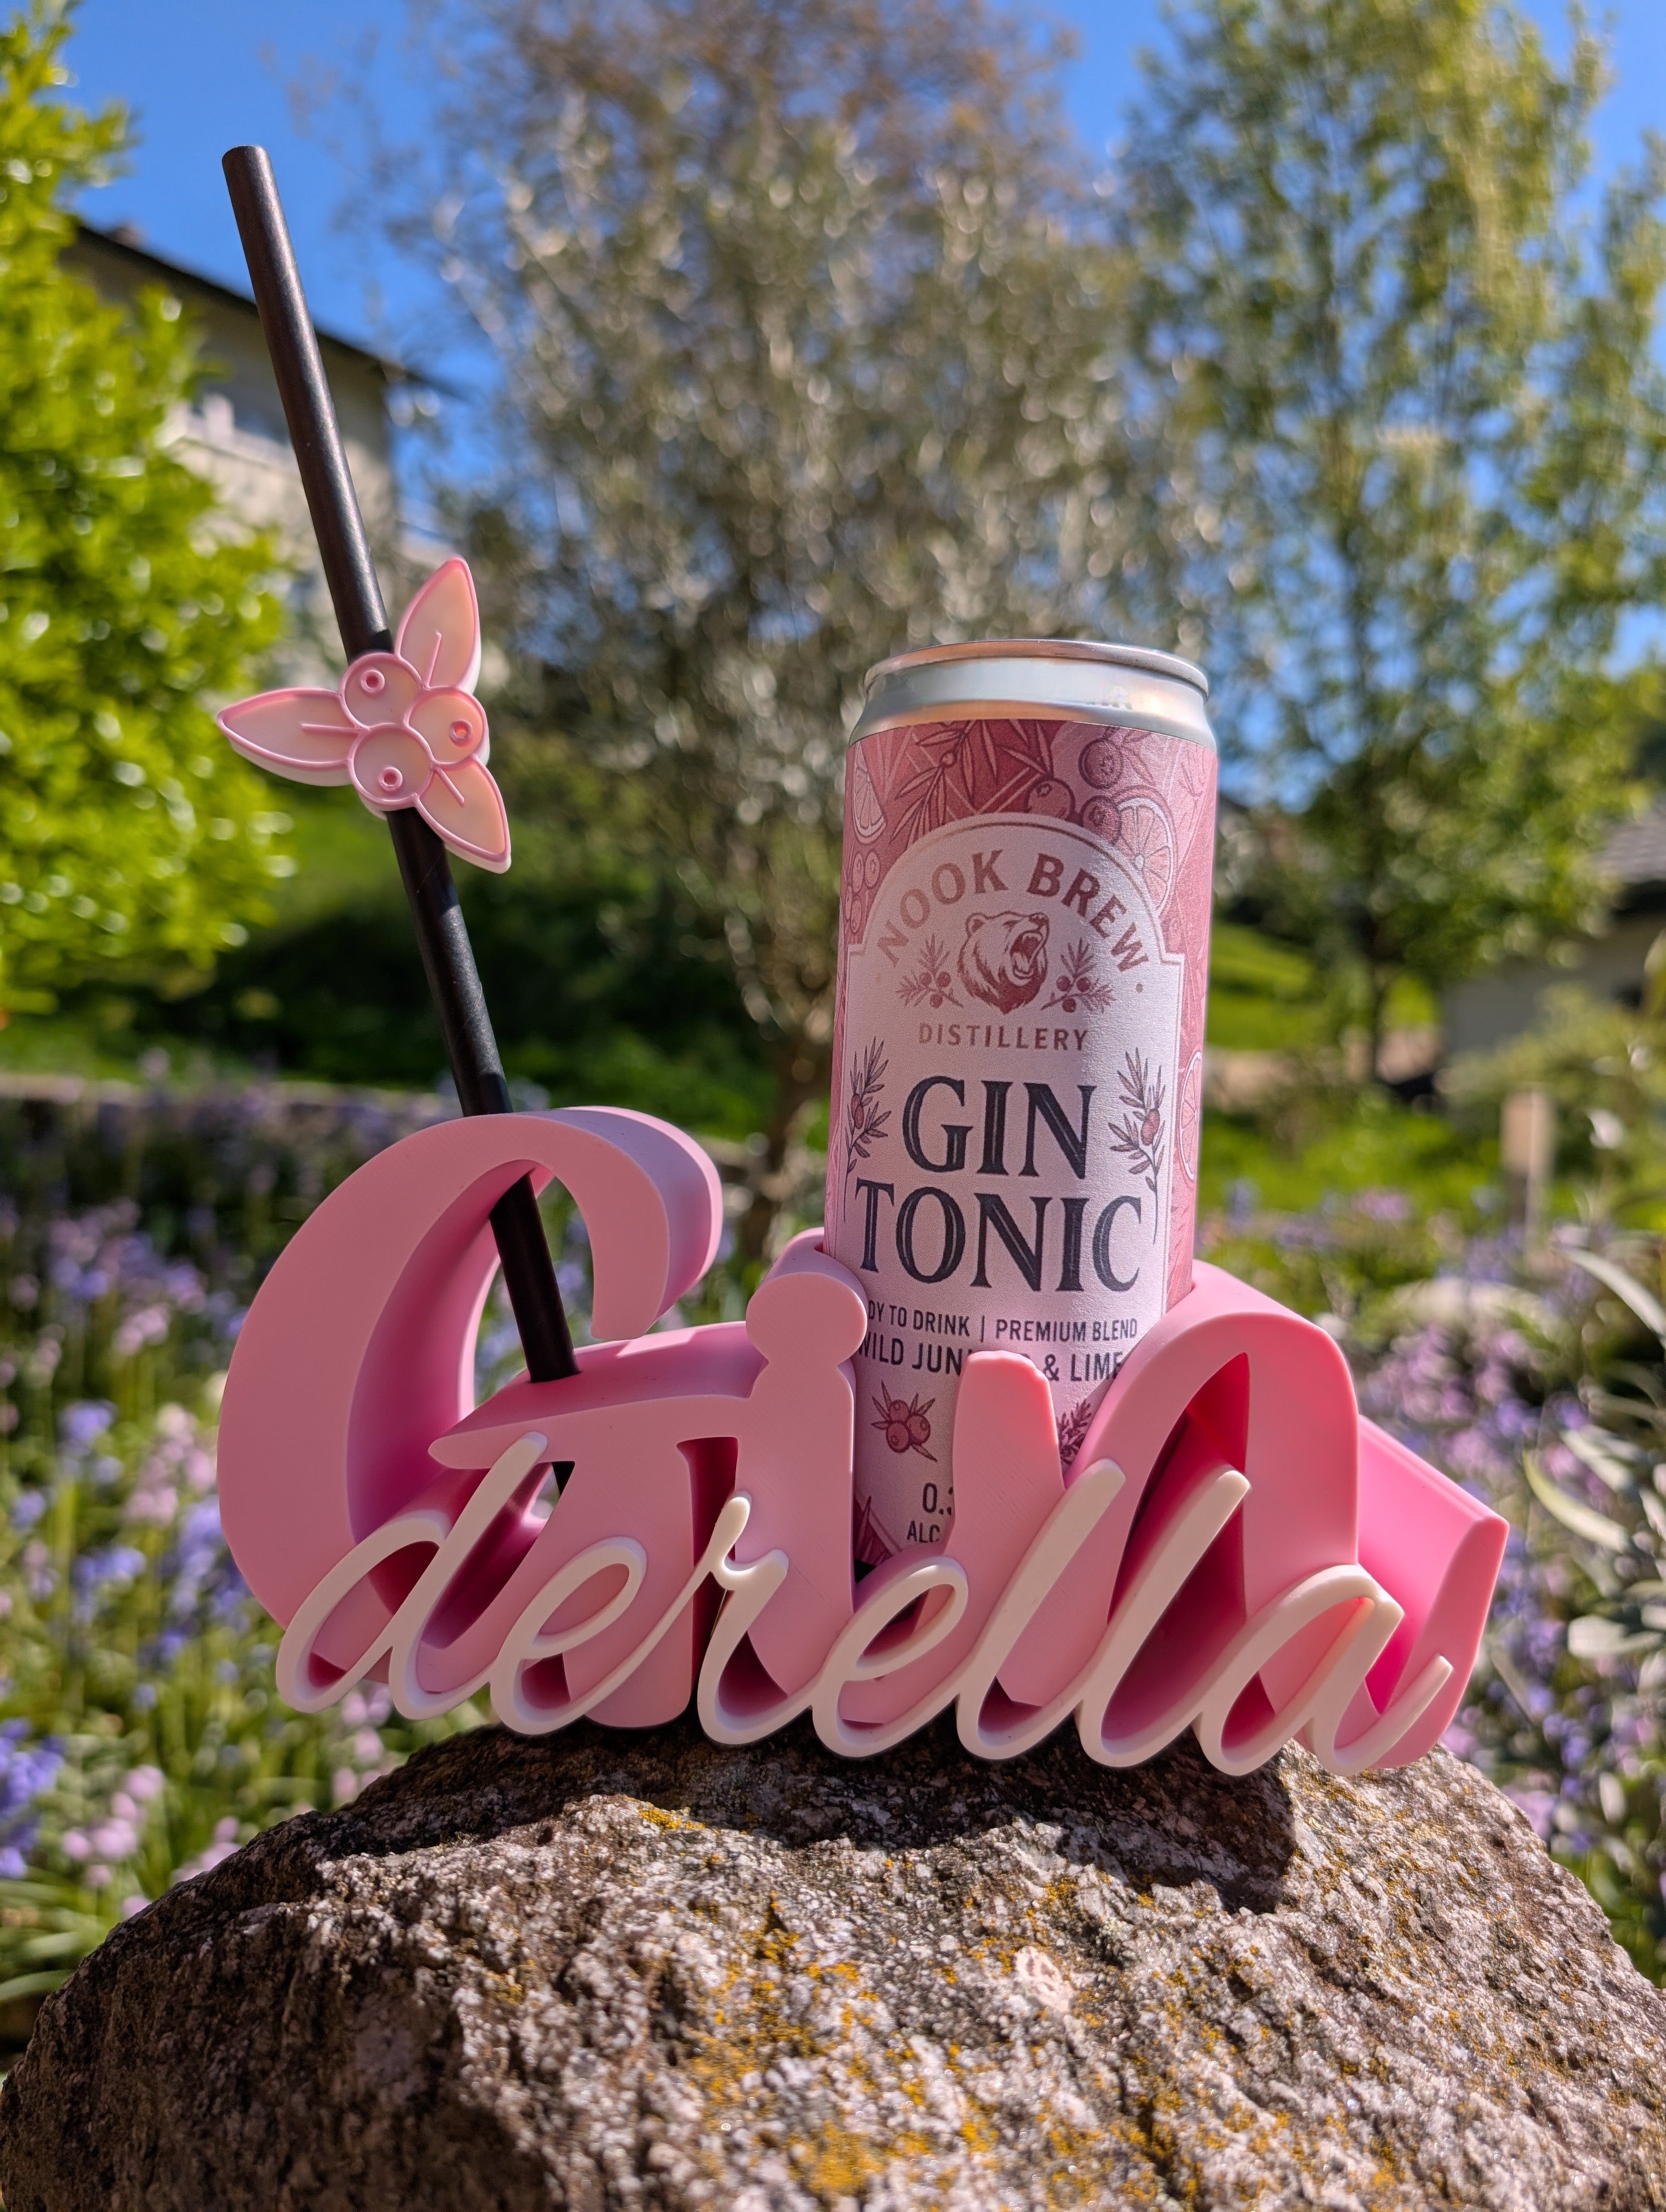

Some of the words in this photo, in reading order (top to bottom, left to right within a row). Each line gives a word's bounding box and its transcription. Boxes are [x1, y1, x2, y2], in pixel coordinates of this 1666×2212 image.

[877, 849, 1008, 967] NOOK
[1027, 852, 1149, 972] BREW
[919, 1023, 1088, 1051] DISTILLERY
[902, 1076, 1097, 1179] GIN
[855, 1178, 1142, 1292] TONIC
[889, 1304, 907, 1328] TO
[913, 1309, 971, 1337] DRINK
[995, 1319, 1086, 1342] PREMIUM
[1092, 1318, 1138, 1341] BLEND
[1043, 1354, 1060, 1382] &
[922, 1482, 953, 1516] 0.
[907, 1520, 940, 1543] ALC
[275, 1431, 1454, 1777] derella
